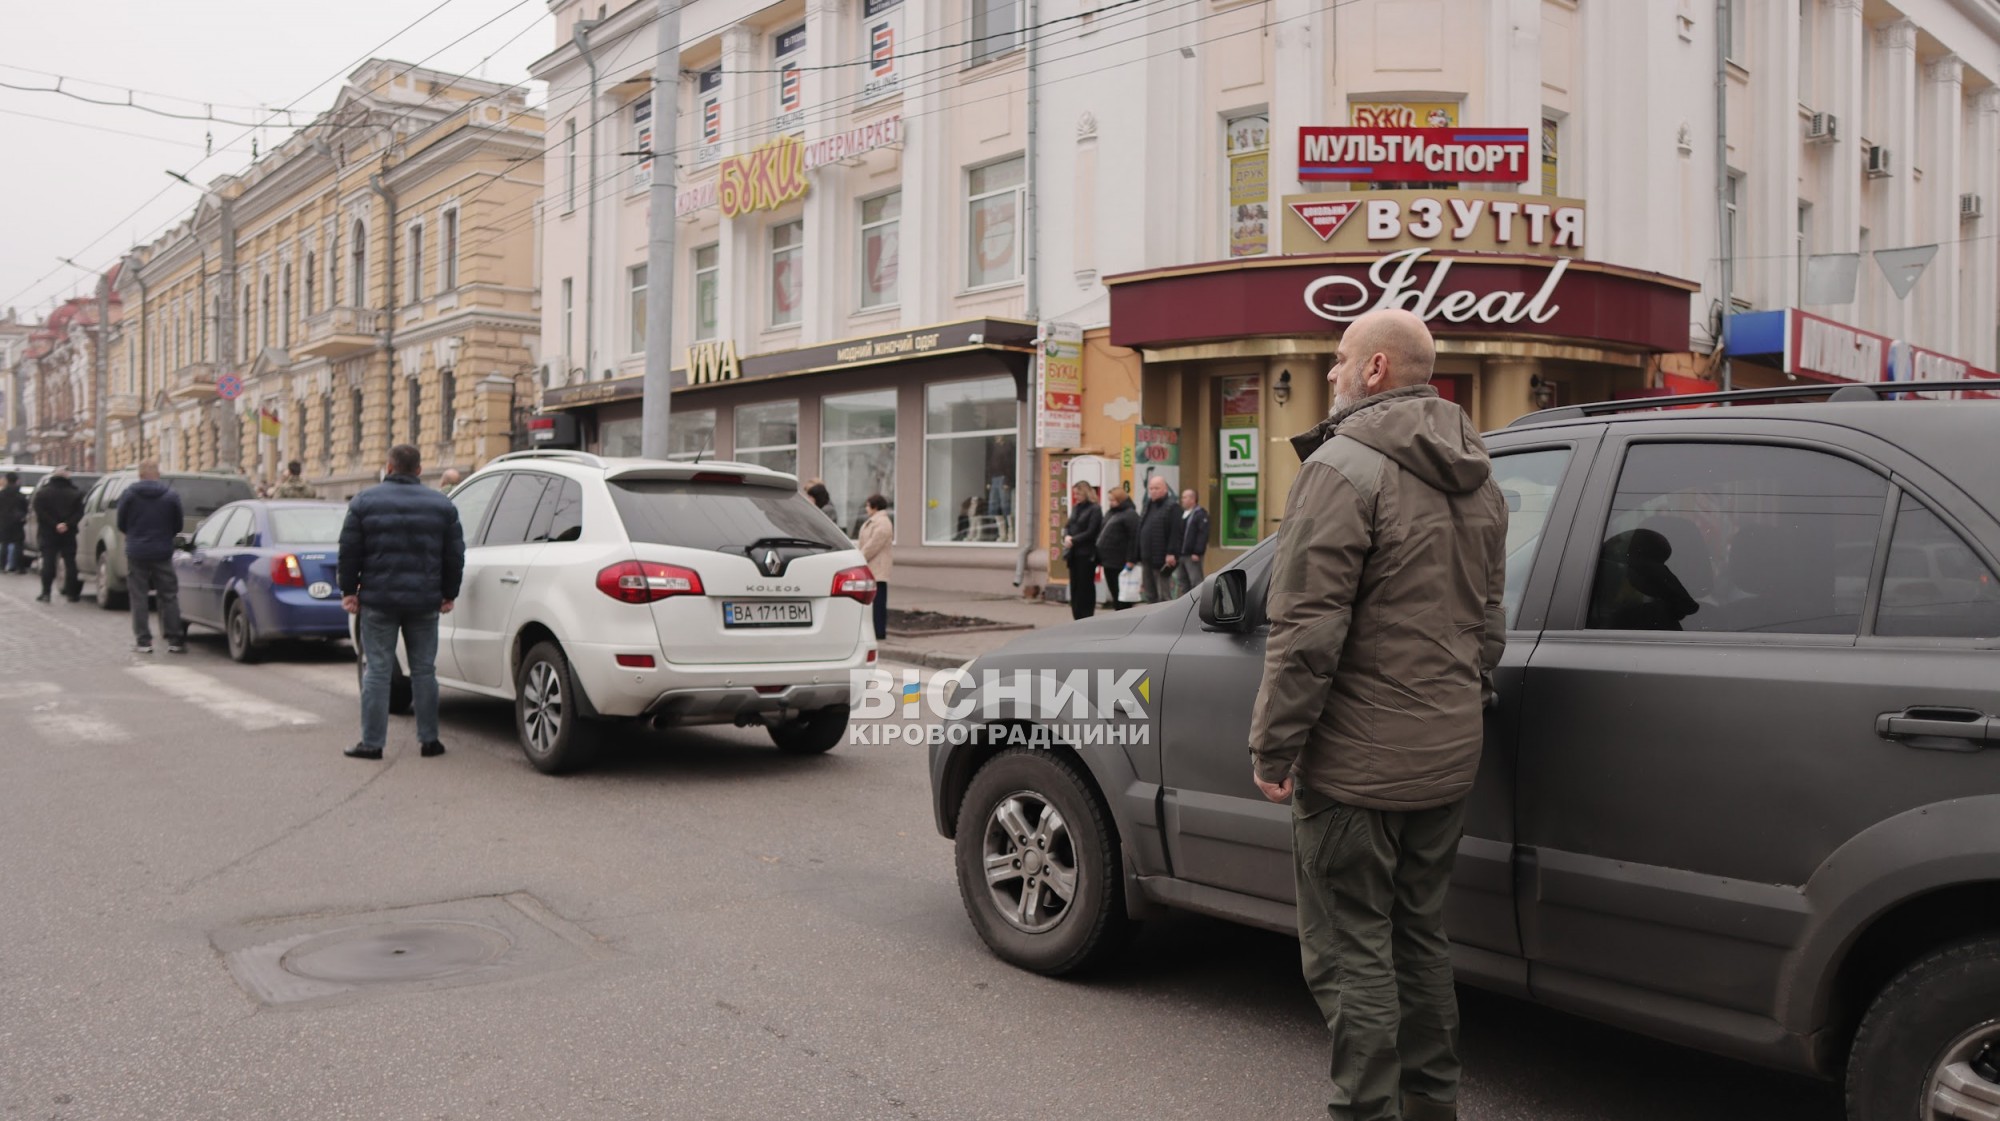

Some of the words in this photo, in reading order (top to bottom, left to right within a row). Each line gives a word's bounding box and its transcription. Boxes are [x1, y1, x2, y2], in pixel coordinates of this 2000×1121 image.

[864, 73, 899, 97] EXLINE
[803, 114, 900, 171] СУПЕРМАРКЕТ
[1304, 135, 1525, 172] МУЛЬТИСПОРТ
[1367, 198, 1585, 248] ВЗУТТЯ
[1303, 247, 1571, 324] Ideal
[837, 341, 873, 362] МОДНИЙ
[873, 334, 914, 356] ЖІНОЧИЙ
[914, 333, 940, 352] ОДЯГ
[312, 585, 328, 595] UA
[734, 605, 753, 621] BA
[757, 605, 785, 620] 1711
[788, 605, 808, 620] BM
